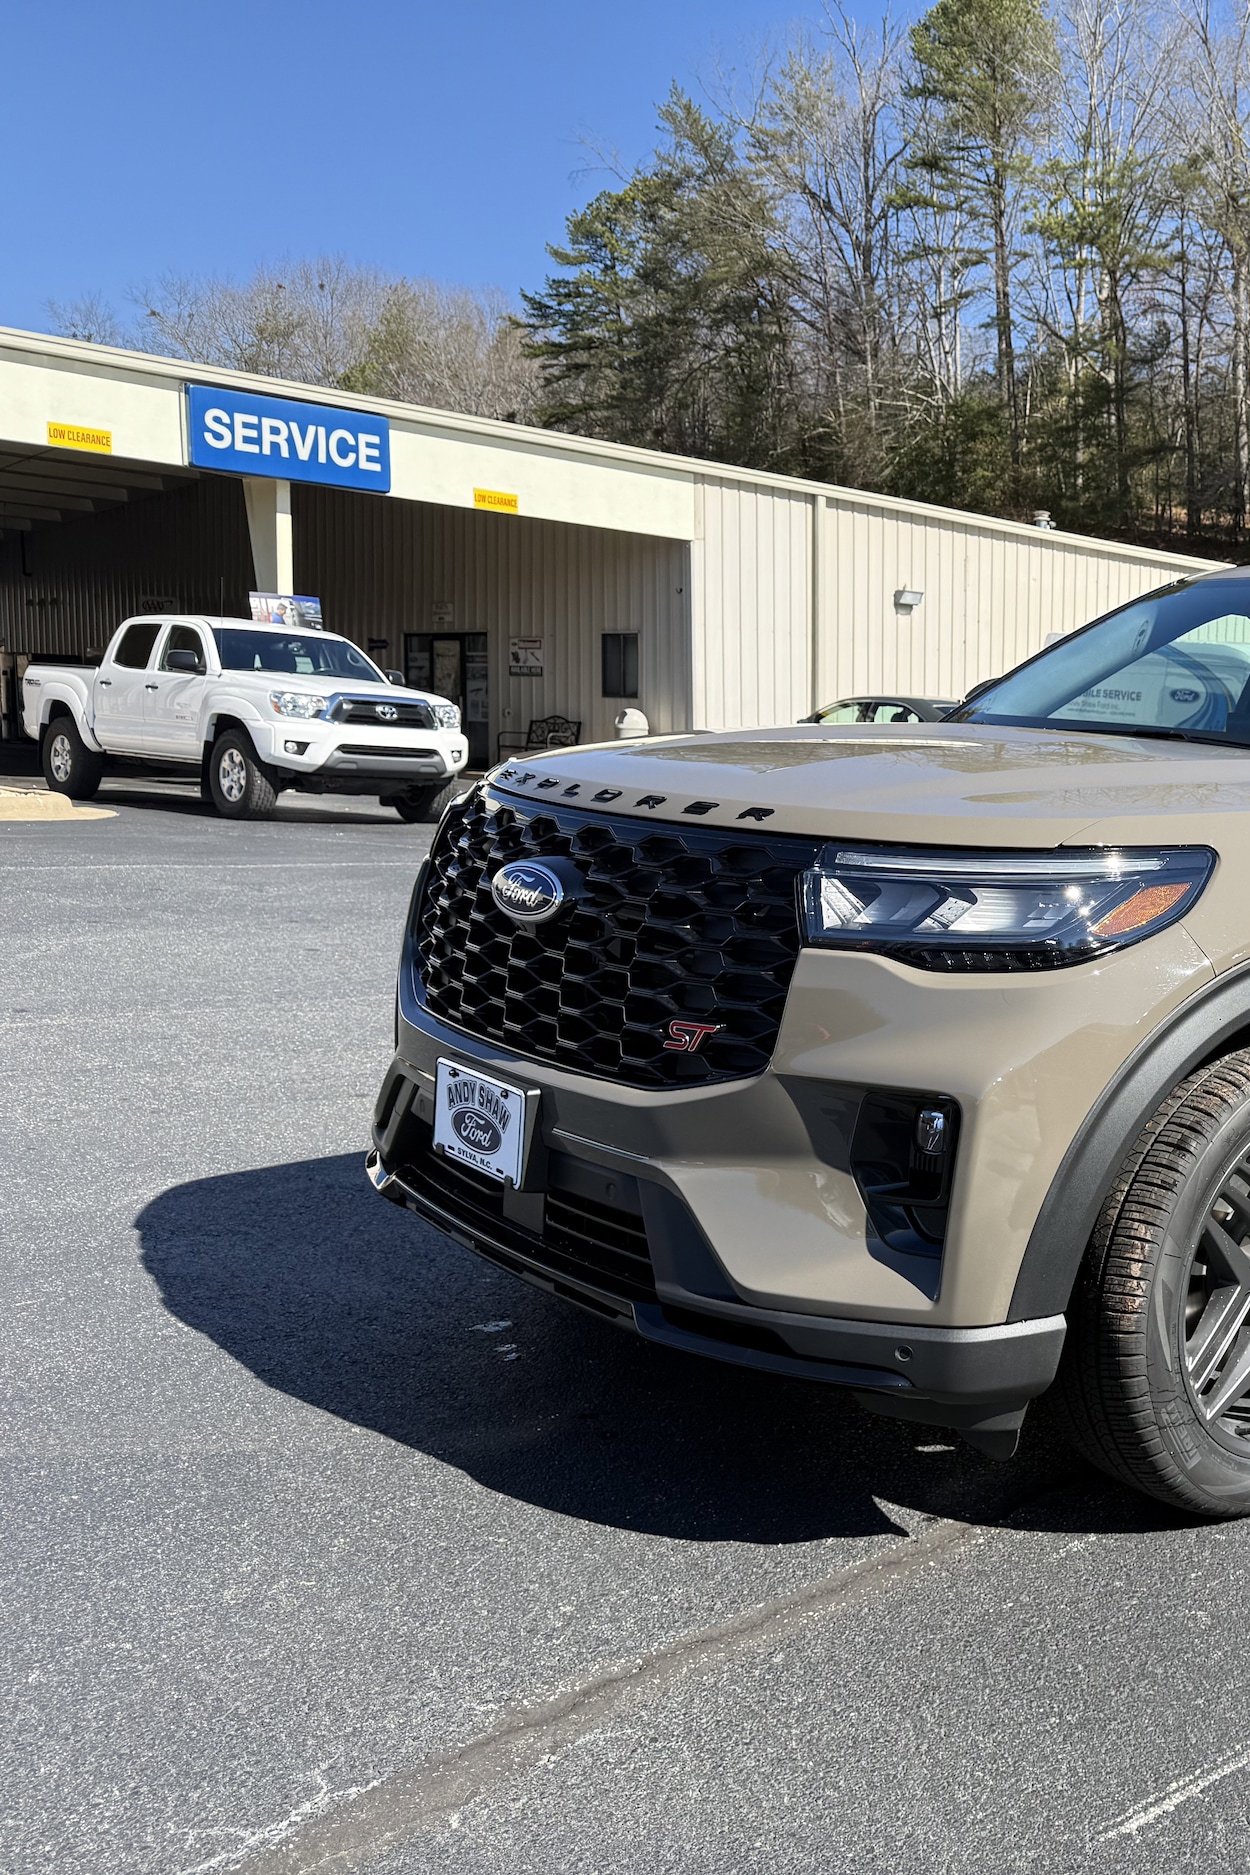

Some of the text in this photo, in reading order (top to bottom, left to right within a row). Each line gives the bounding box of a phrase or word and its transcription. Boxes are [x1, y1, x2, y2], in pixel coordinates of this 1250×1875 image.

[48, 427, 111, 448] LOW CLEARANCE
[203, 408, 382, 472] SERVICE
[474, 493, 518, 509] LOW CLEARANCE
[1103, 689, 1142, 702] SERVICE
[502, 872, 542, 908] Ford
[662, 1019, 717, 1052] ST
[446, 1079, 512, 1134] ANDY SHAW
[461, 1112, 492, 1148] Ford
[457, 1147, 493, 1170] SYLVA, N.C.
